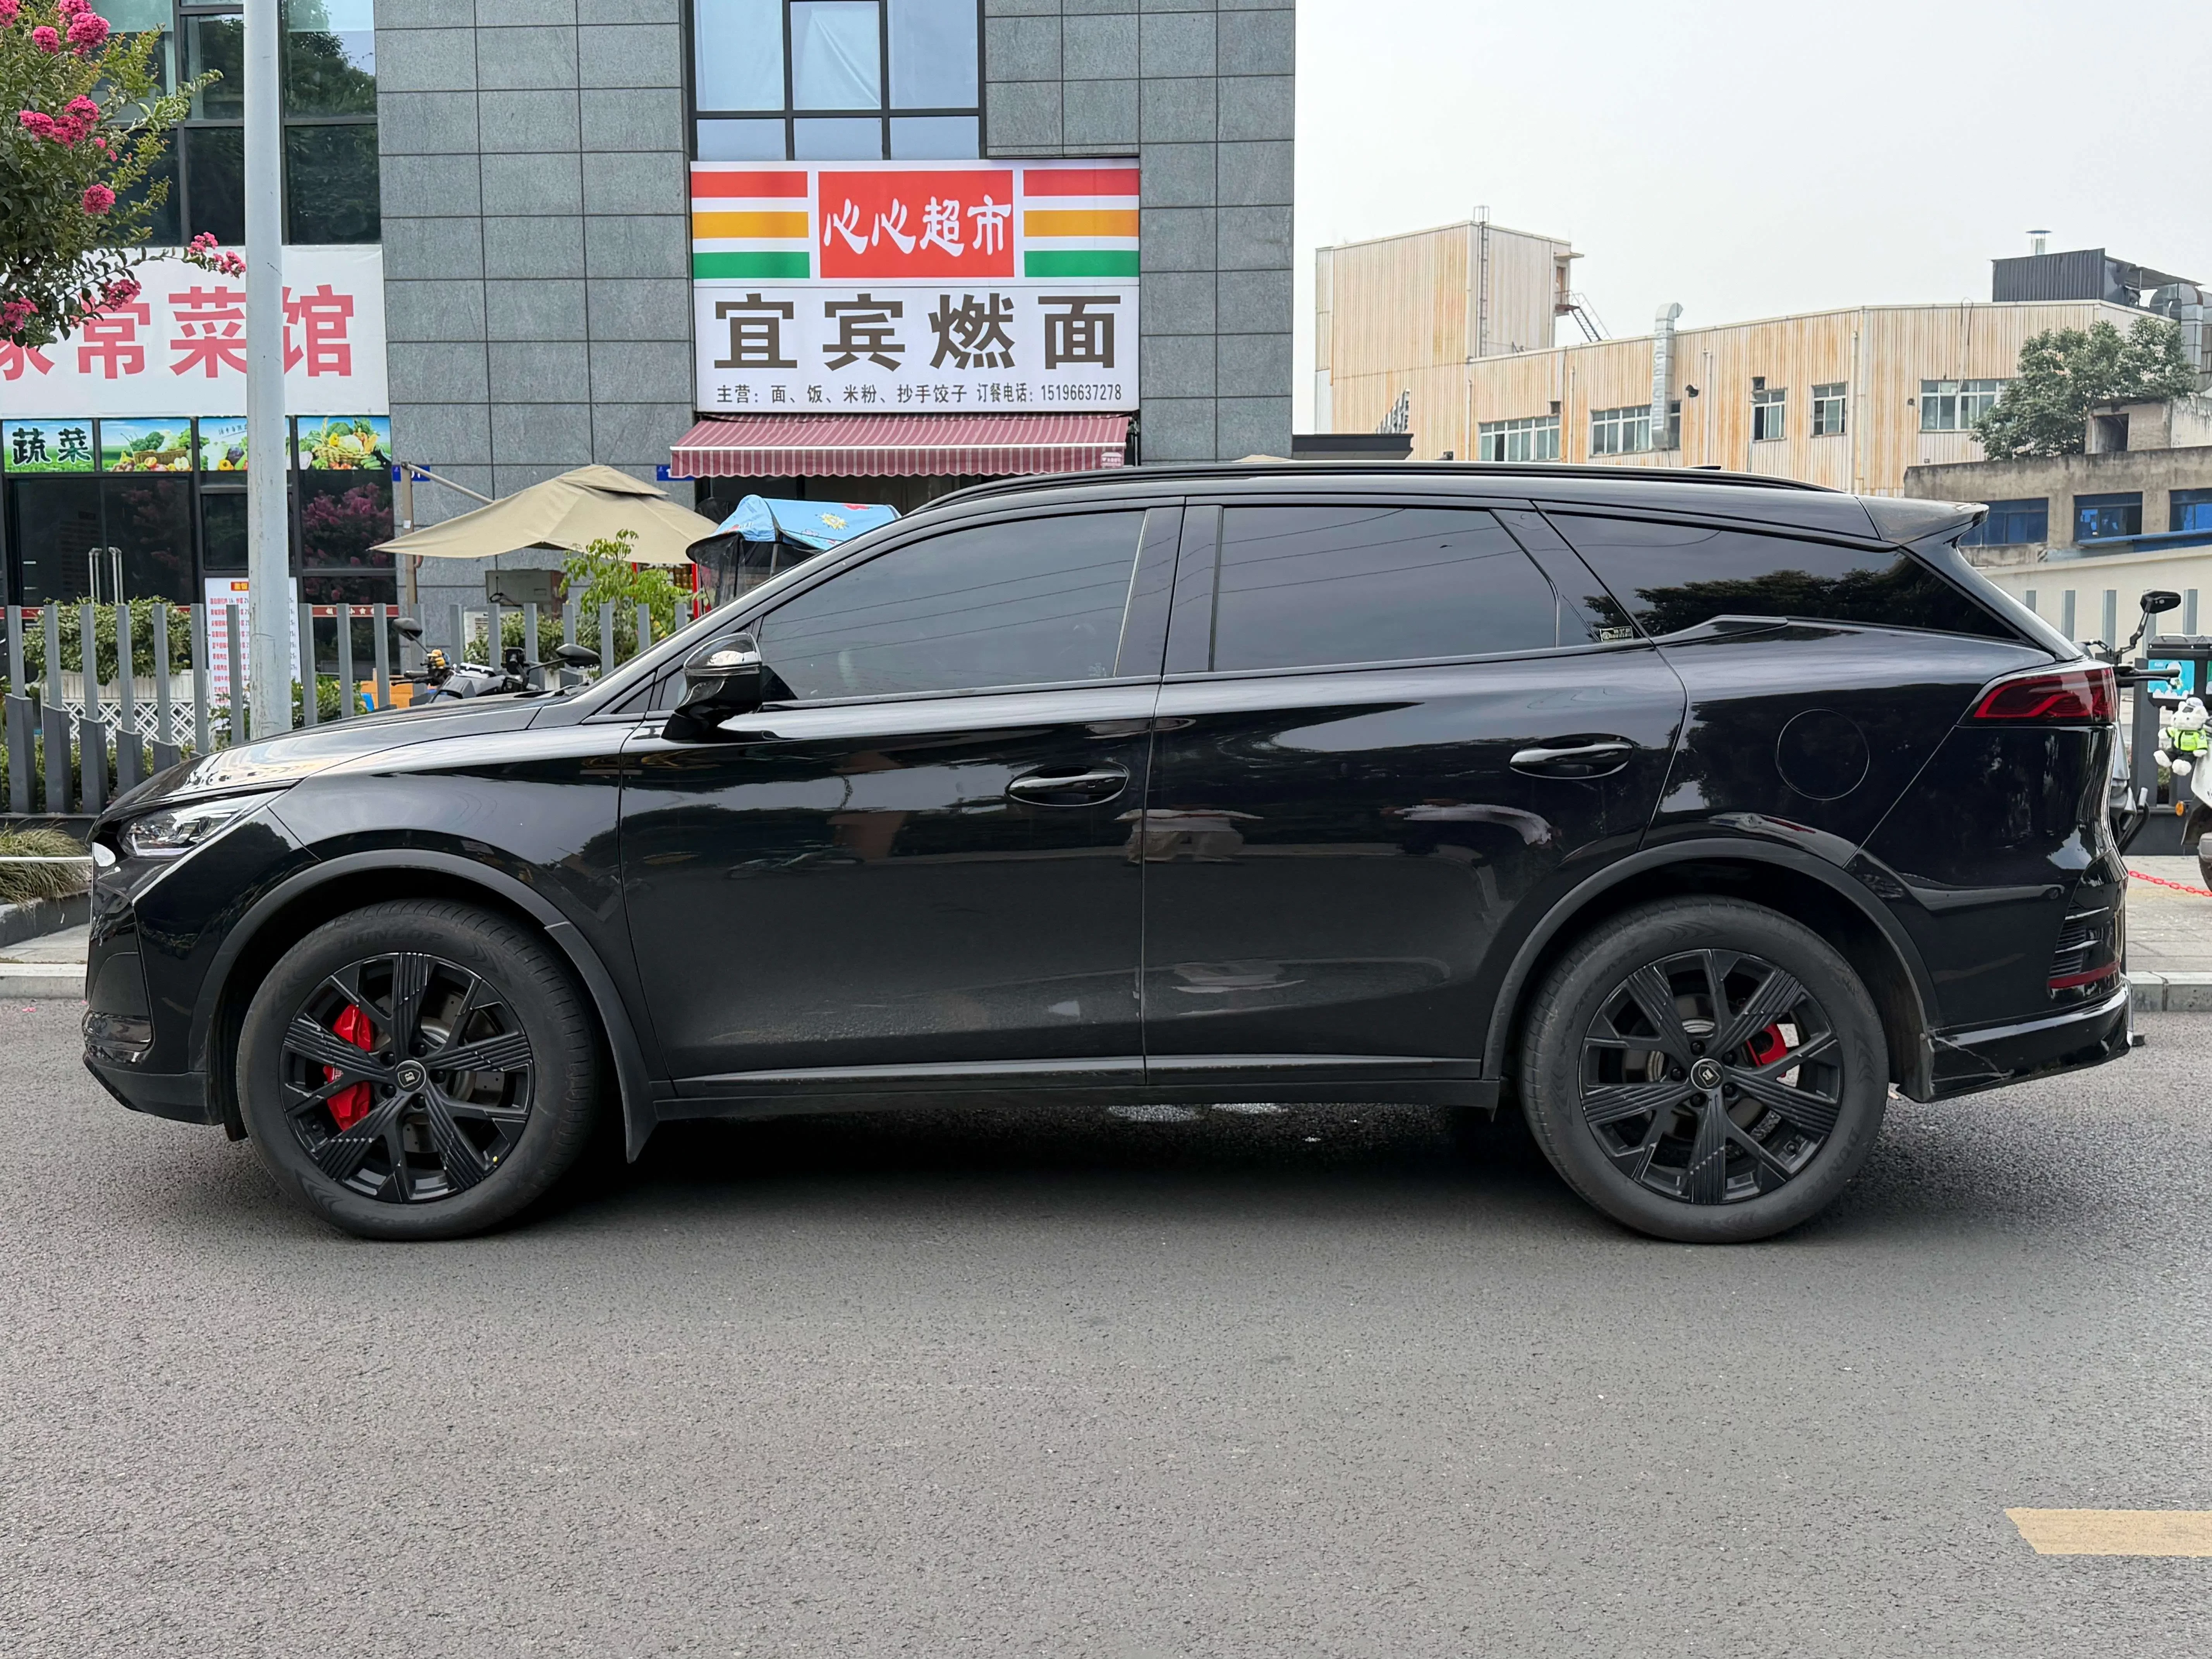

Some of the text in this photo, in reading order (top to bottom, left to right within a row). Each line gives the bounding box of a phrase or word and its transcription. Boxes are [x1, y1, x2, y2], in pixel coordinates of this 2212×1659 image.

[824, 195, 1012, 257] 心心超市
[714, 293, 1121, 373] 宜宾燃面
[12, 427, 91, 465] 蔬菜
